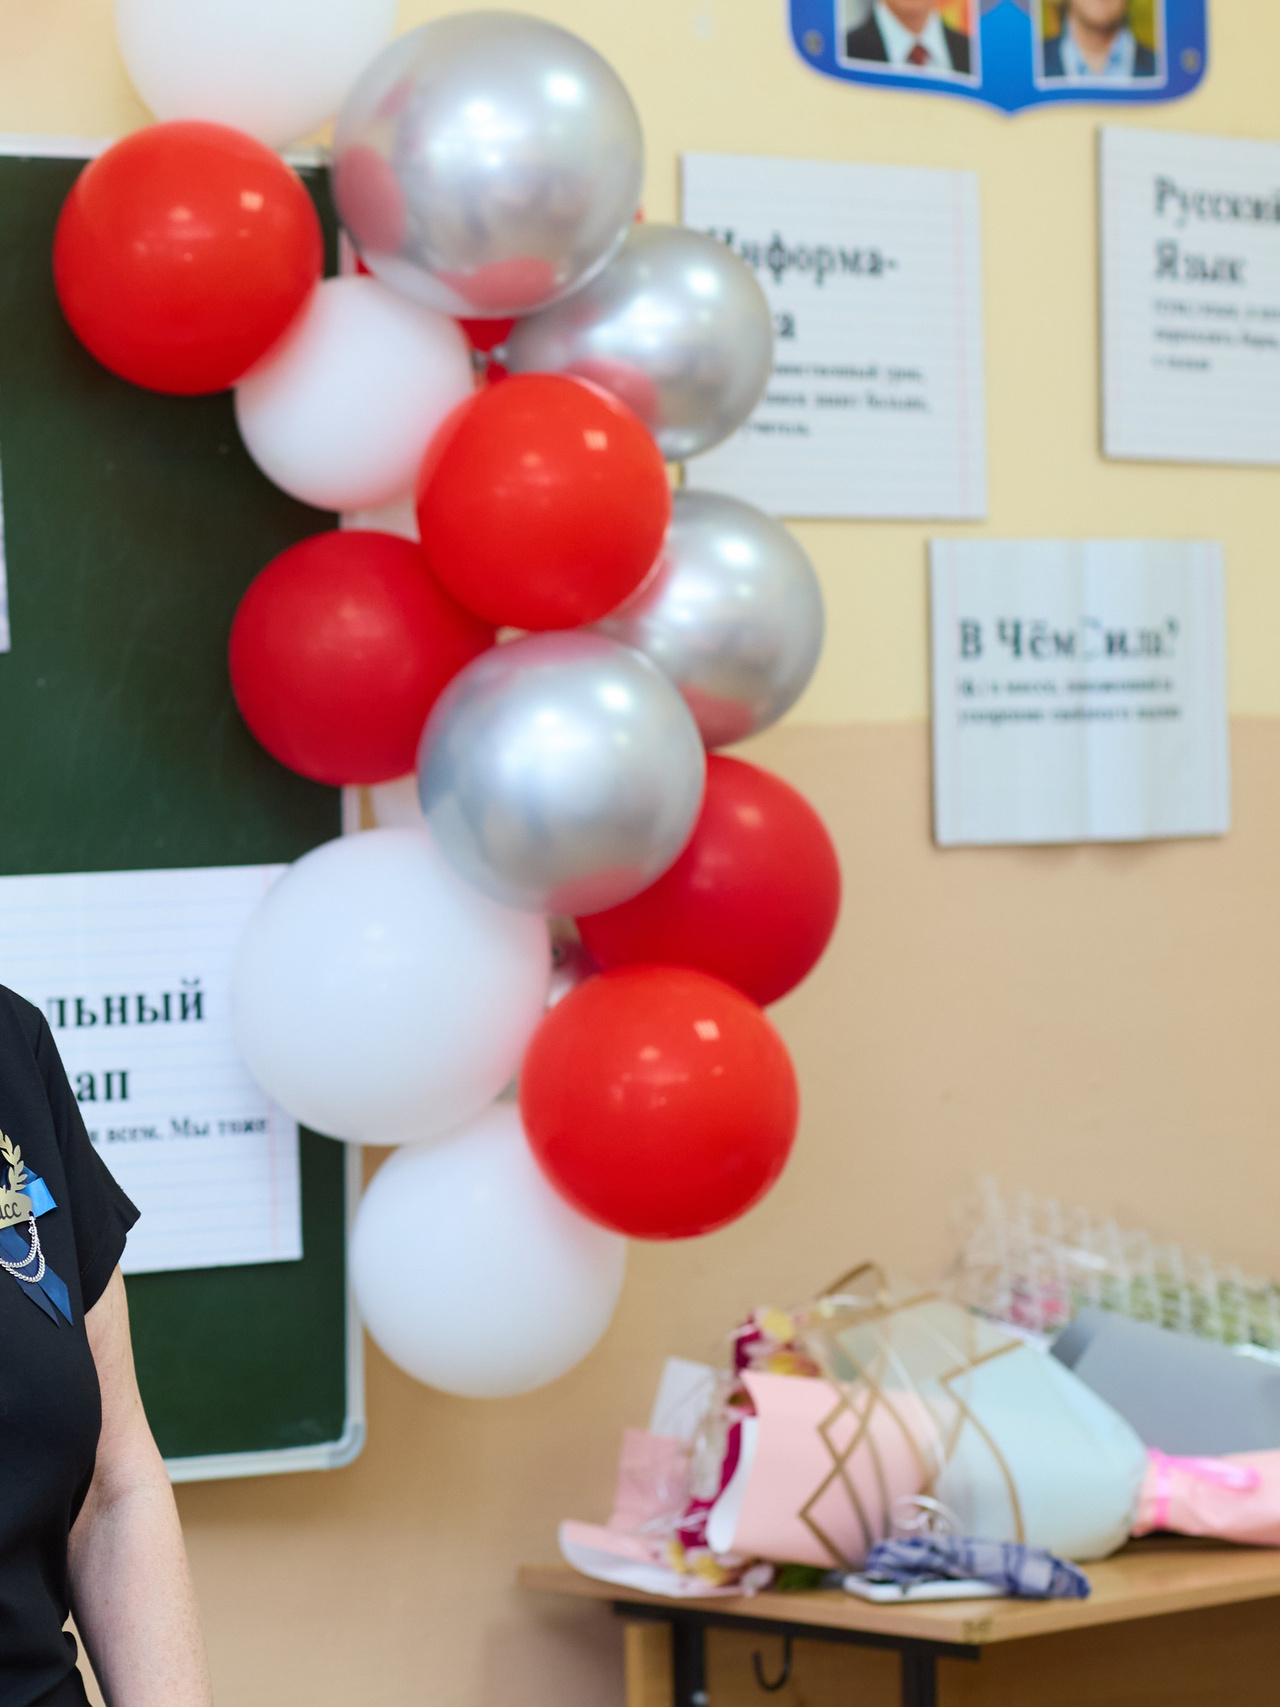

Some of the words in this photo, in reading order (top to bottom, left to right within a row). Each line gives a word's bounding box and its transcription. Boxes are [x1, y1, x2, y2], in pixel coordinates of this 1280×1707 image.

[1154, 239, 1245, 285] Язык
[960, 618, 983, 661] В
[46, 977, 204, 1029] льный
[74, 1069, 129, 1102] ап
